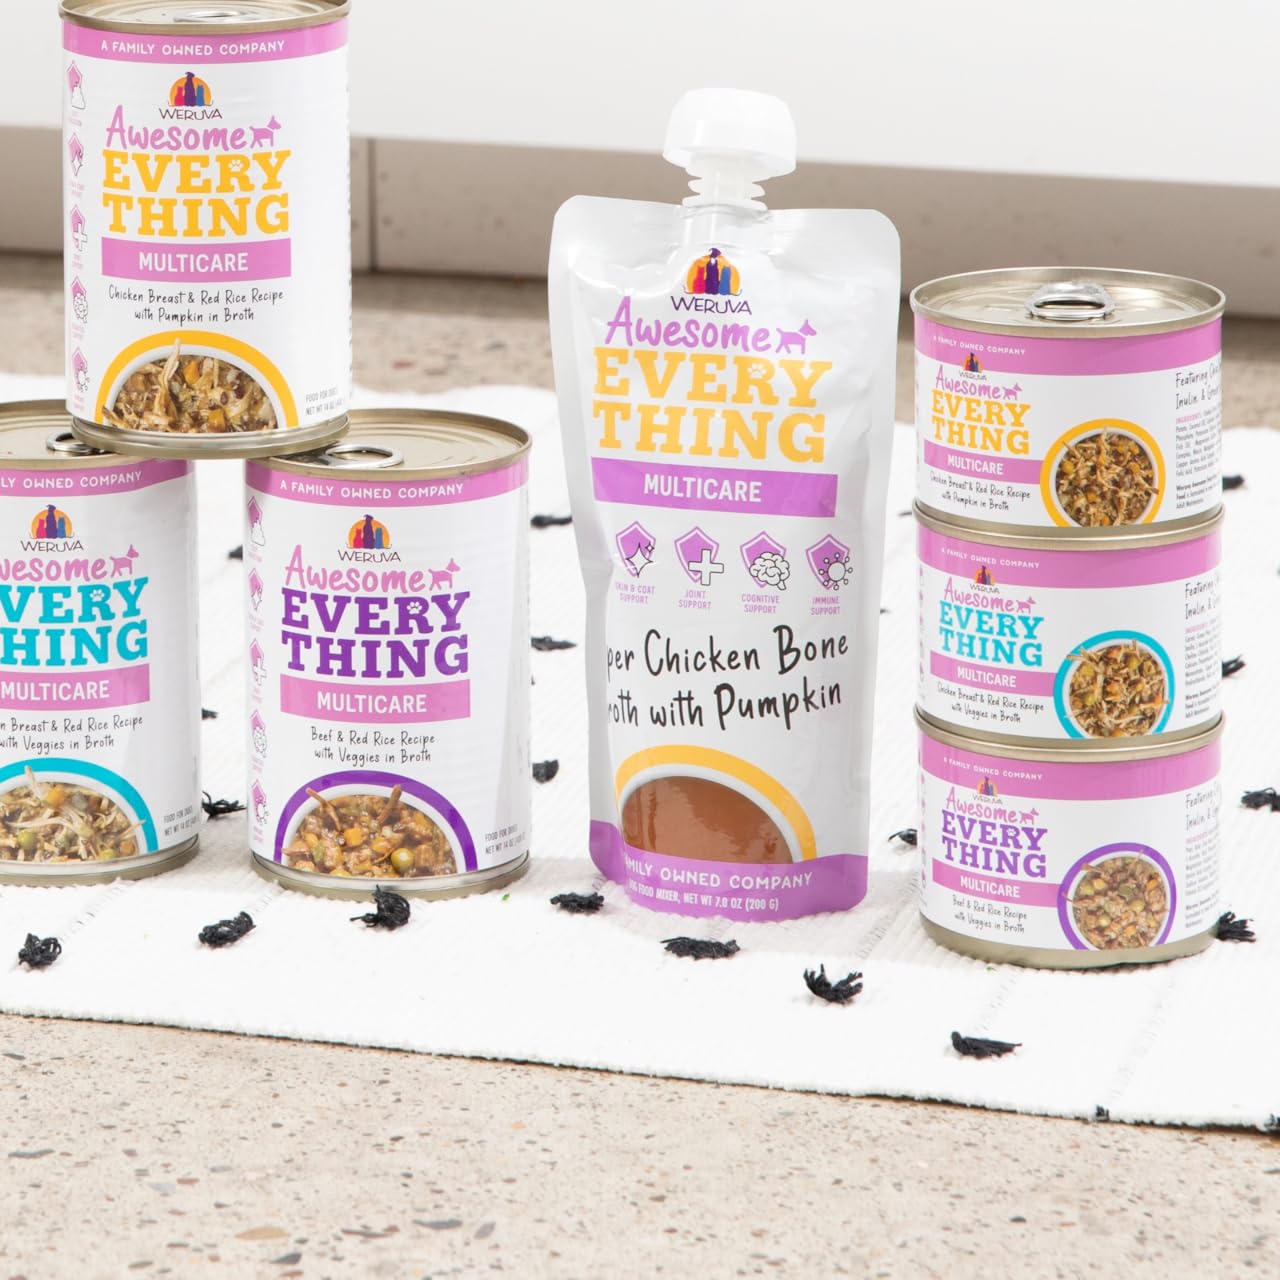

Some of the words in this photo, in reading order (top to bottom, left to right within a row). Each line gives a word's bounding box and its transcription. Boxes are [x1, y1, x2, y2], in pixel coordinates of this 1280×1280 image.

[101, 40, 108, 51] A
[112, 41, 156, 55] FAMILY
[162, 45, 213, 56] OWNED
[220, 40, 285, 55] COMPANY
[159, 108, 222, 120] WERUVA
[106, 104, 247, 151] Awesome
[102, 149, 291, 194] EVERY
[102, 192, 289, 238] THING
[139, 252, 249, 272] MULTICARE
[108, 284, 144, 302] Chicken
[148, 288, 186, 304] Breast
[188, 292, 195, 304] &
[201, 290, 220, 304] Red
[225, 290, 247, 304] Rice
[251, 288, 284, 305] Recipe
[670, 295, 752, 315] WERUVA
[134, 307, 153, 321] with
[158, 307, 204, 326] Pumpkin
[209, 308, 218, 322] in
[223, 307, 254, 322] Broth
[604, 295, 772, 353] Awesome
[959, 342, 984, 352] OWNED
[987, 345, 1025, 355] COMPANY
[593, 346, 833, 408] EVERY
[935, 364, 1001, 400] Awesome
[931, 388, 1031, 427] EVERY
[592, 399, 826, 463] THING
[931, 414, 1030, 455] THING
[947, 454, 1004, 475] MULTICARE
[23, 477, 74, 489] OWNED
[80, 470, 142, 488] COMPANY
[280, 479, 288, 490] A
[291, 481, 334, 497] FAMILY
[341, 488, 391, 499] OWNED
[398, 483, 464, 499] COMPANY
[643, 473, 762, 503] MULTICARE
[976, 483, 988, 495] Red
[990, 484, 1004, 497] Rice
[1007, 486, 1033, 502] Recipe
[989, 498, 1009, 511] Broth
[20, 540, 84, 553] WERUVA
[337, 549, 401, 563] WERUVA
[284, 544, 426, 594] Awesome
[970, 554, 996, 565] OWNED
[1000, 559, 1040, 569] COMPANY
[620, 592, 648, 604] SUPPORT
[637, 585, 656, 595] COAT
[686, 590, 706, 599] JOINT
[741, 593, 780, 604] COGNITIVE
[812, 596, 840, 605] IMMUNE
[943, 576, 1014, 613] Awesome
[281, 587, 470, 635] EVERY
[678, 599, 712, 609] SUPPORT
[744, 604, 776, 614] SUPPORT
[810, 606, 840, 615] SUPPORT
[939, 600, 1045, 640] EVERY
[281, 630, 469, 679] THING
[644, 629, 760, 676] Chicken
[773, 624, 849, 675] Bone
[939, 626, 1043, 667] THING
[957, 666, 1017, 688] MULTICARE
[1, 680, 110, 701] MULTICARE
[317, 691, 427, 713] MULTICARE
[650, 690, 704, 728] with
[714, 676, 841, 731] Pumpkin
[963, 703, 988, 720] Veggies
[987, 694, 1000, 707] Red
[1002, 696, 1017, 709] Rice
[1020, 698, 1045, 713] Recipe
[11, 718, 49, 732] Breast
[51, 720, 58, 732] &
[64, 718, 83, 732] Red
[88, 717, 109, 731] Rice
[113, 714, 143, 730] Recipe
[23, 735, 65, 755] Veggies
[69, 736, 79, 749] in
[85, 735, 114, 748] Broth
[311, 726, 333, 743] Beef
[337, 730, 344, 742] &
[349, 730, 368, 745] Red
[374, 731, 395, 745] Rice
[401, 731, 435, 746] Recipe
[314, 747, 334, 761] with
[338, 748, 380, 767] Veggies
[385, 750, 395, 763] in
[401, 749, 431, 763] Broth
[948, 759, 971, 770] FAMILY
[1002, 770, 1043, 781] COMPANY
[946, 786, 1018, 823] Awesome
[941, 809, 1048, 851] EVERY
[941, 835, 1047, 878] THING
[660, 867, 721, 887] OWNED
[729, 871, 813, 890] COMPANY
[960, 875, 1020, 898] MULTICARE
[638, 883, 654, 898] FOOD
[683, 892, 698, 905] NET
[700, 894, 713, 907] WT
[715, 896, 728, 908] 7.0
[730, 897, 742, 910] OZ
[745, 897, 766, 912] (200
[768, 898, 779, 912] G)
[973, 901, 985, 913] Red
[988, 903, 1001, 916] Rice
[1004, 905, 1027, 920] Recipe
[967, 914, 992, 930] Veggies
[1004, 921, 1025, 933] Broth
